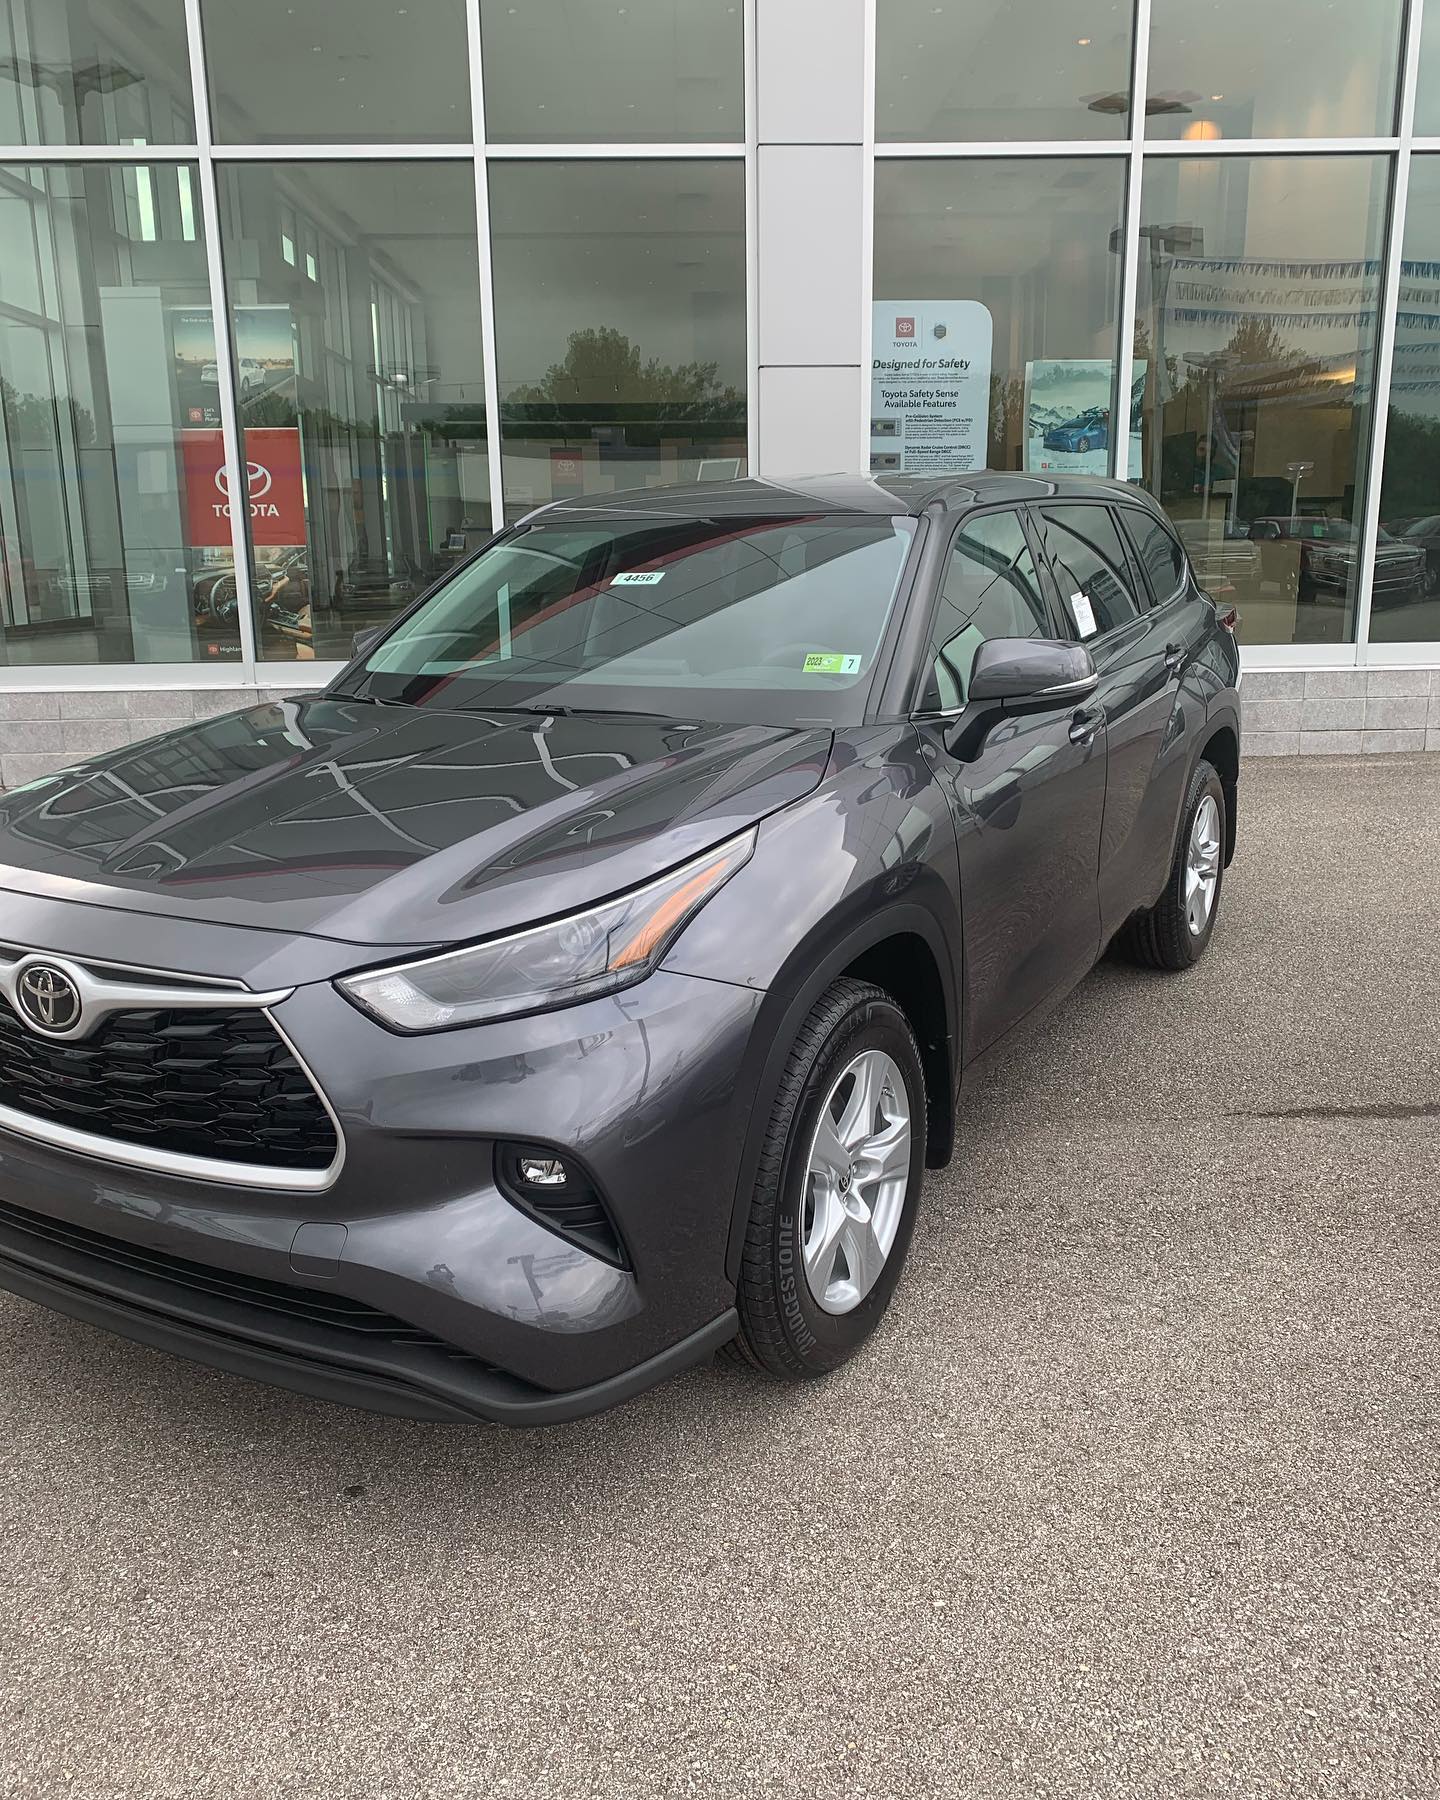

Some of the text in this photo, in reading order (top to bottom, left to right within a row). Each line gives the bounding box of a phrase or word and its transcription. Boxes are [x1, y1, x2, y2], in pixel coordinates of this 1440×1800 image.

[873, 358, 971, 371] Designed for Safety
[881, 389, 959, 399] Toyota Safety Sense
[884, 399, 957, 408] Available Features
[212, 504, 280, 518] TOOTA
[623, 573, 656, 582] 4456
[806, 656, 823, 666] 2023
[847, 658, 855, 670] 7
